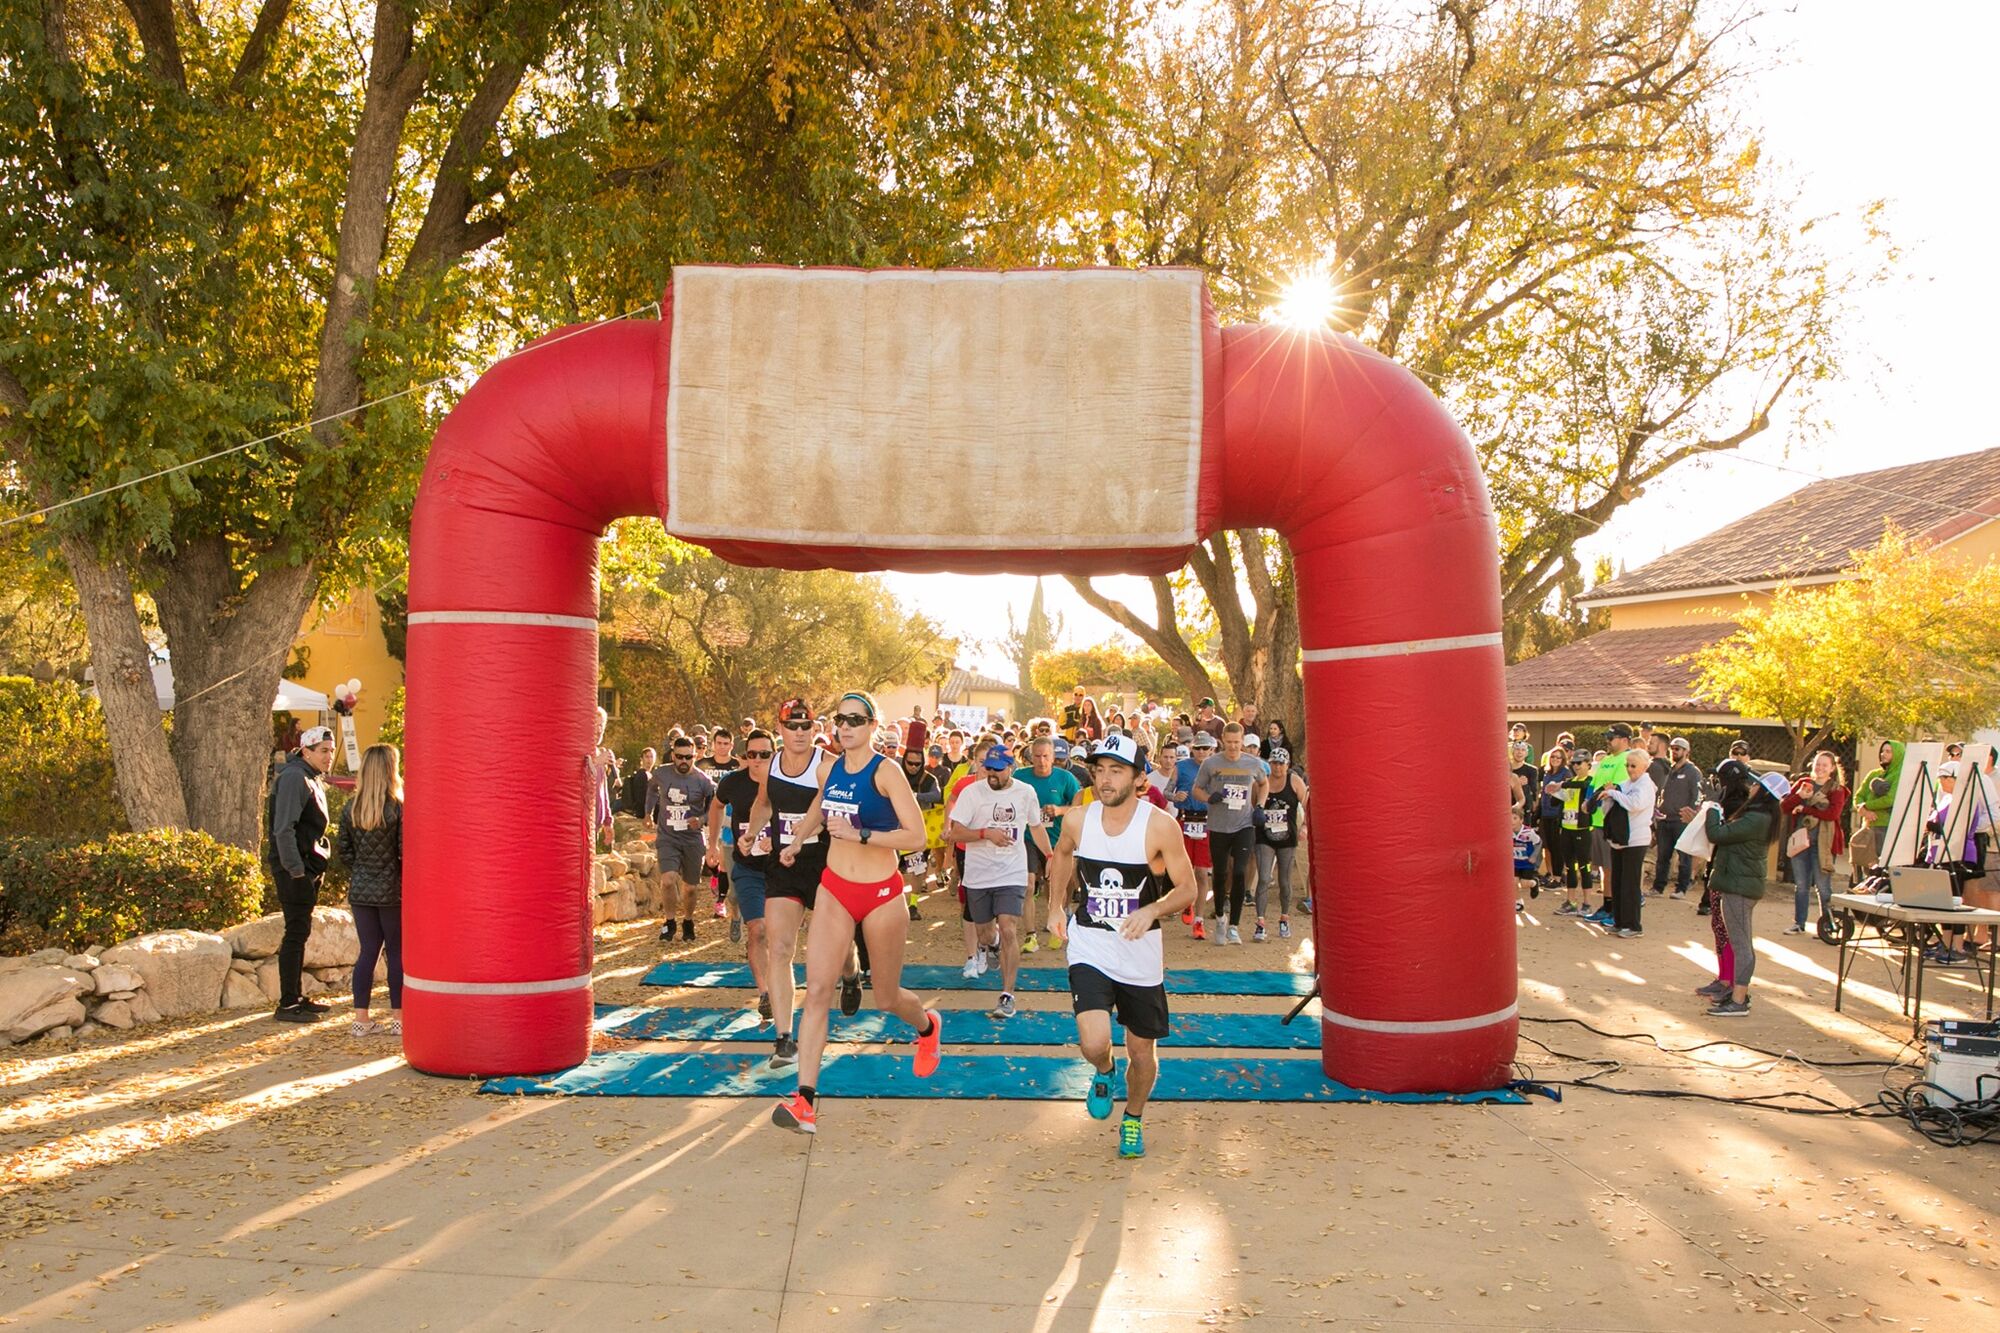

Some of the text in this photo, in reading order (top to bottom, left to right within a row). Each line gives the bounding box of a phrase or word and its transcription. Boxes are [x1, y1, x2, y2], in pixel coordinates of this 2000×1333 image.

[1227, 788, 1244, 799] 325
[669, 809, 687, 820] 307
[1095, 897, 1129, 918] 301
